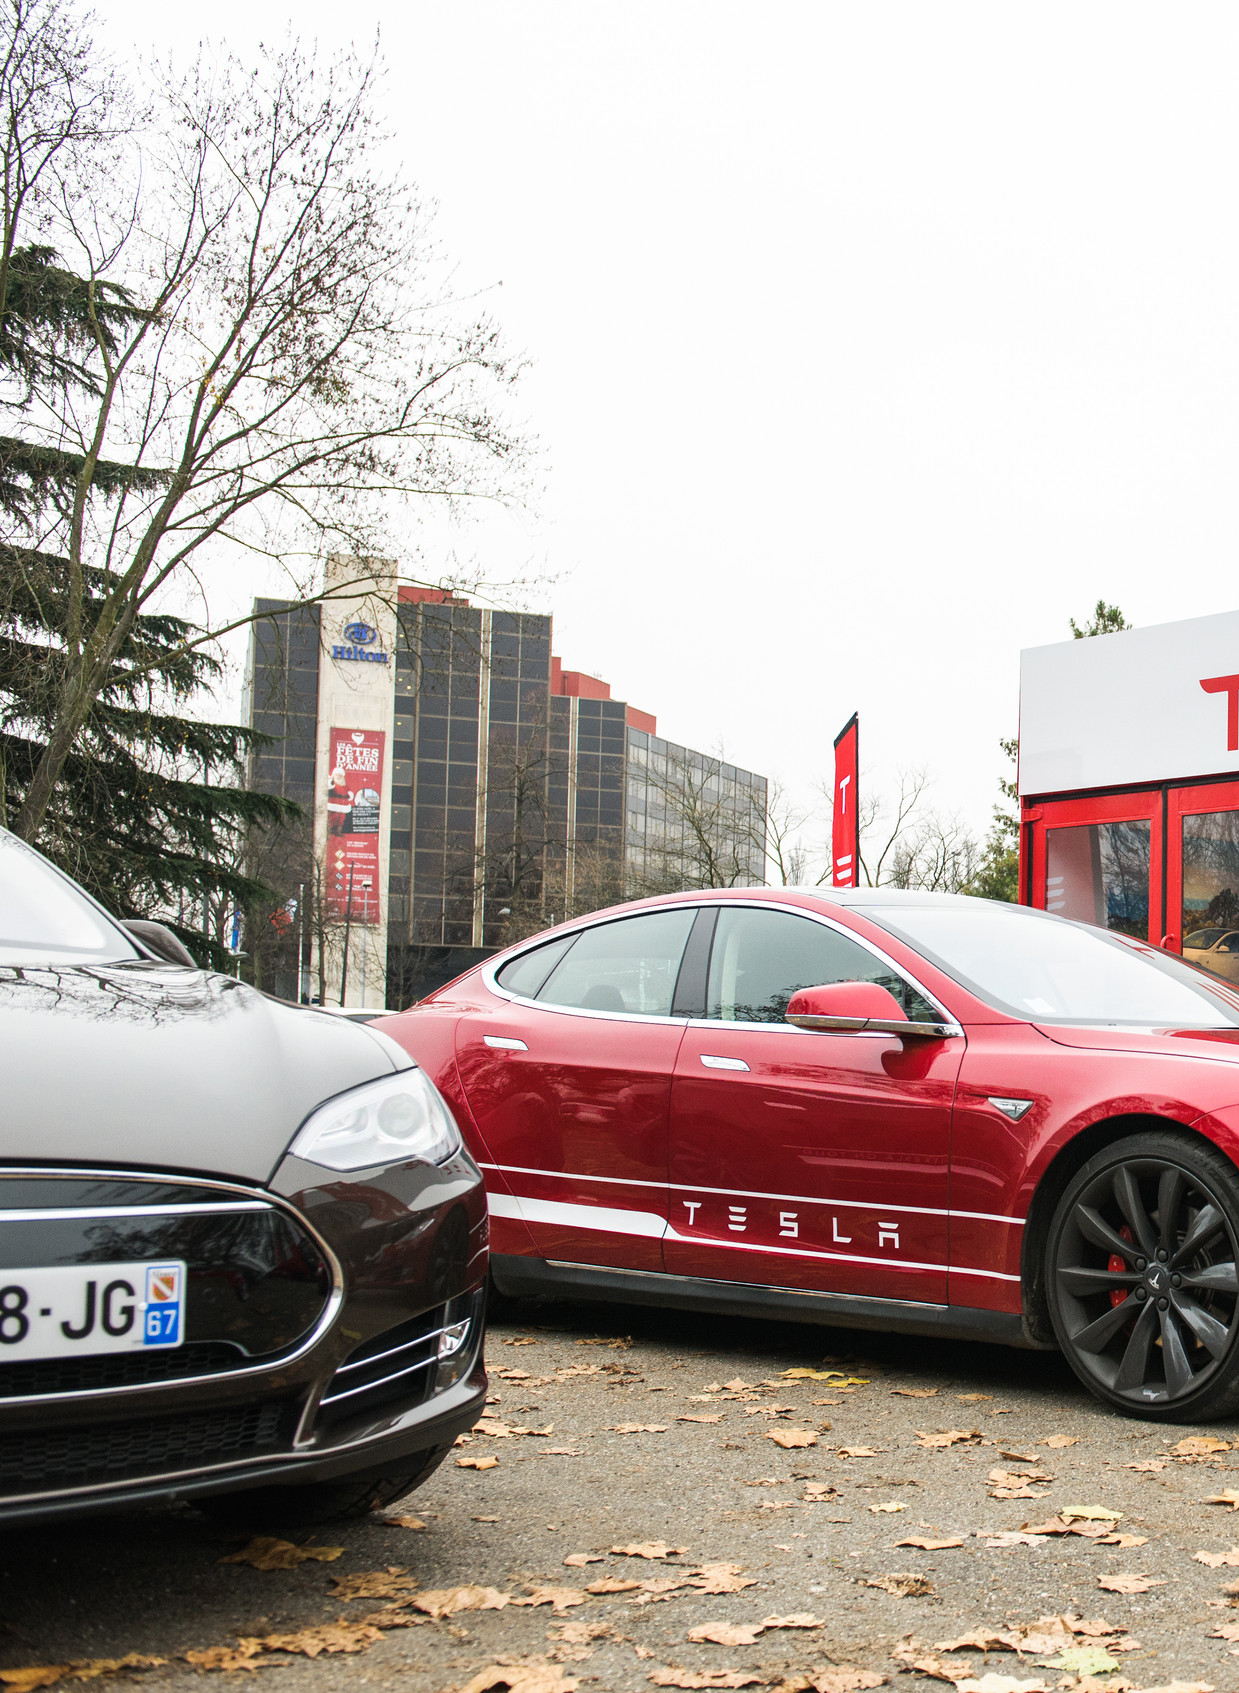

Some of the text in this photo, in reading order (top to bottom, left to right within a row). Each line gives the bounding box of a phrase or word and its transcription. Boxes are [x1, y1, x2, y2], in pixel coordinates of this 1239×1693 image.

[332, 645, 388, 663] Hilton
[337, 743, 380, 758] FÊTES
[336, 755, 379, 766] DE FIN
[683, 1201, 900, 1249] TESLA
[147, 1310, 177, 1337] 67
